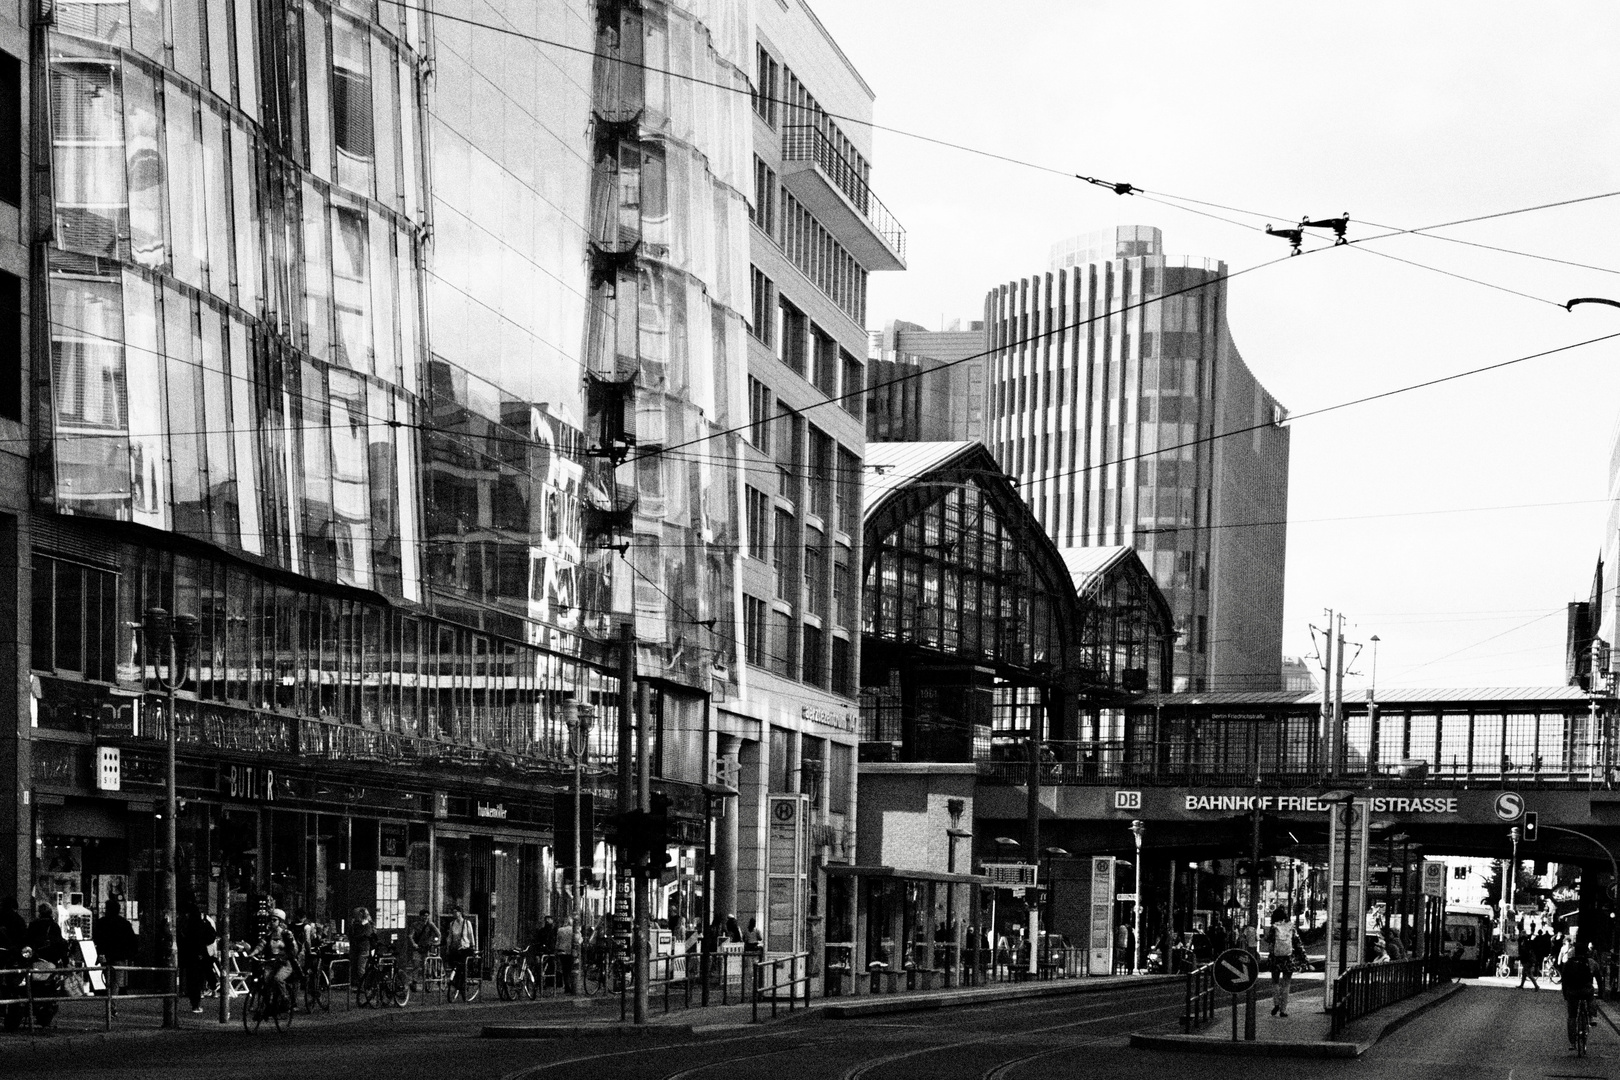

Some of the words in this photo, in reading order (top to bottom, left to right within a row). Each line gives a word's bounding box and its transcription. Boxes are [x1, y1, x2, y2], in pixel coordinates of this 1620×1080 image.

[1211, 712, 1227, 720] Berlin
[1117, 793, 1139, 807] DB
[1185, 795, 1273, 811] BAHNHOF
[1498, 794, 1520, 819] S
